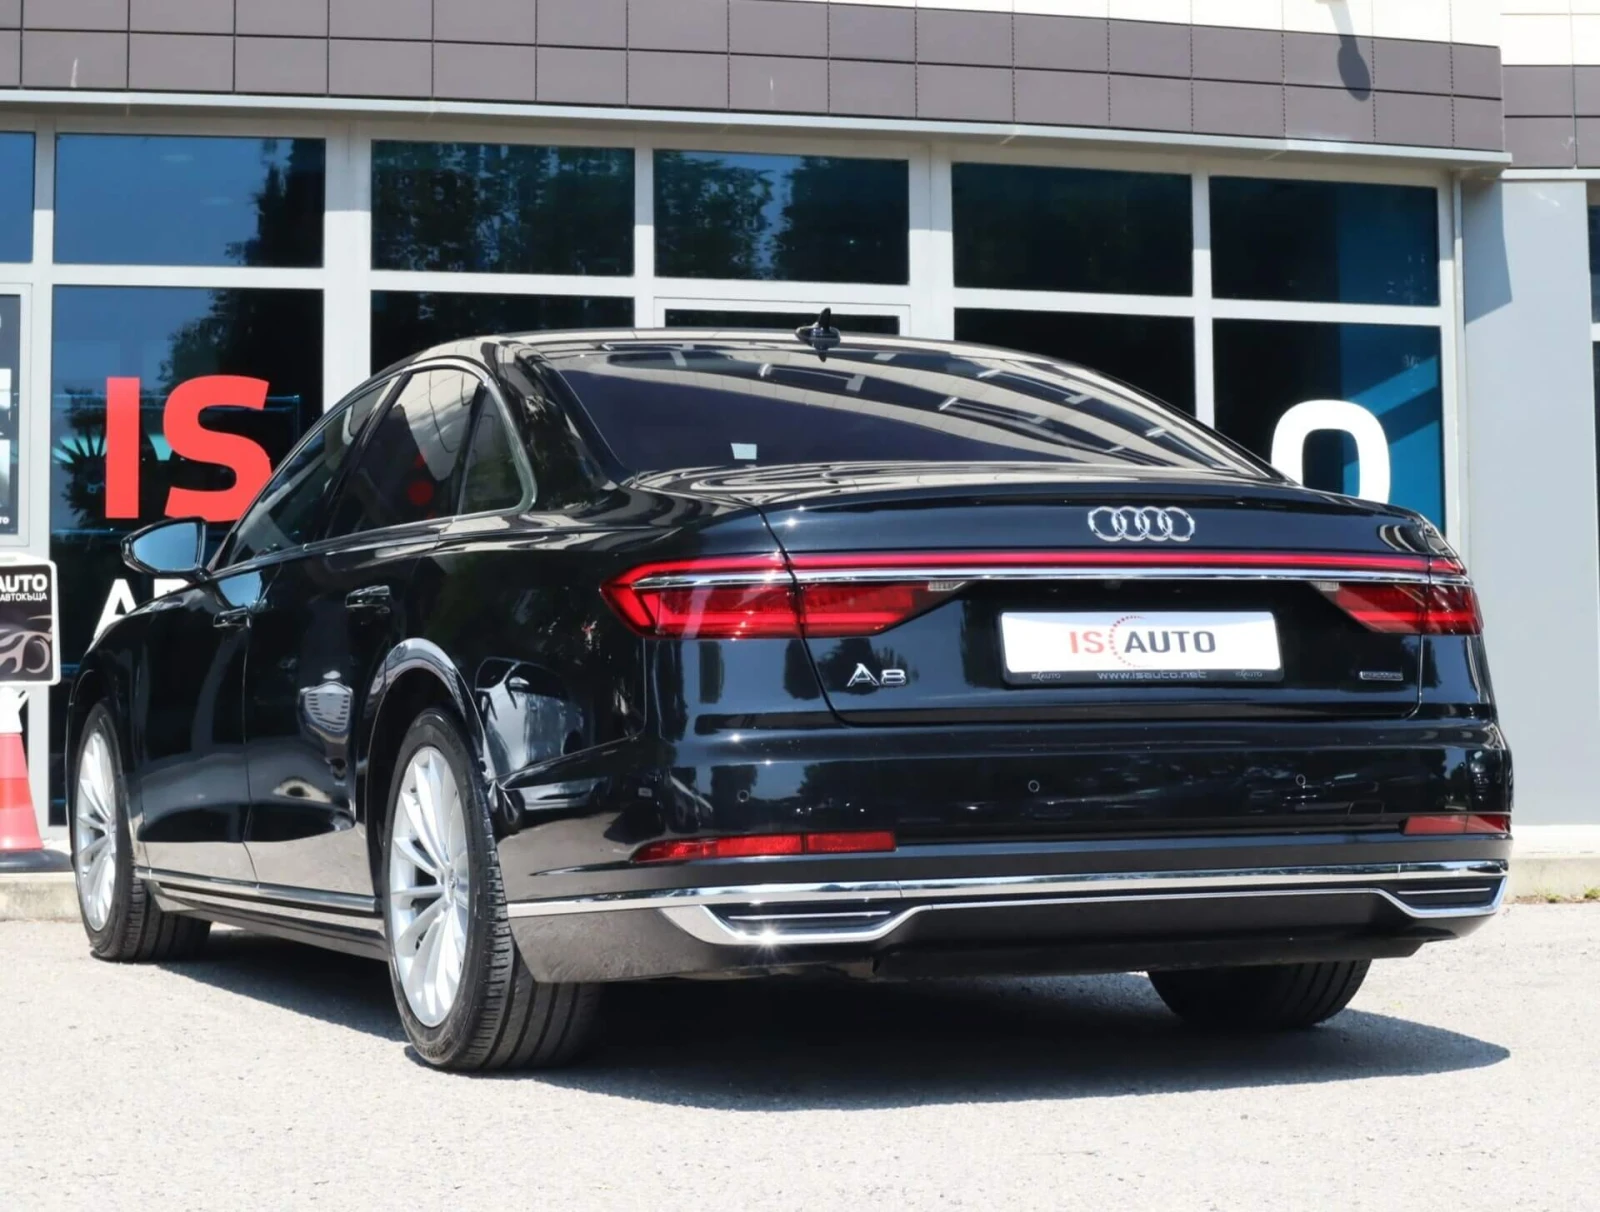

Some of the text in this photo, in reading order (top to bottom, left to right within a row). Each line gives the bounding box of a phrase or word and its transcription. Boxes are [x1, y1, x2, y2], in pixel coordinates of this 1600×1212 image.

[105, 374, 272, 522] IS
[1069, 631, 1216, 654] IS AUTO
[847, 662, 906, 687] A8
